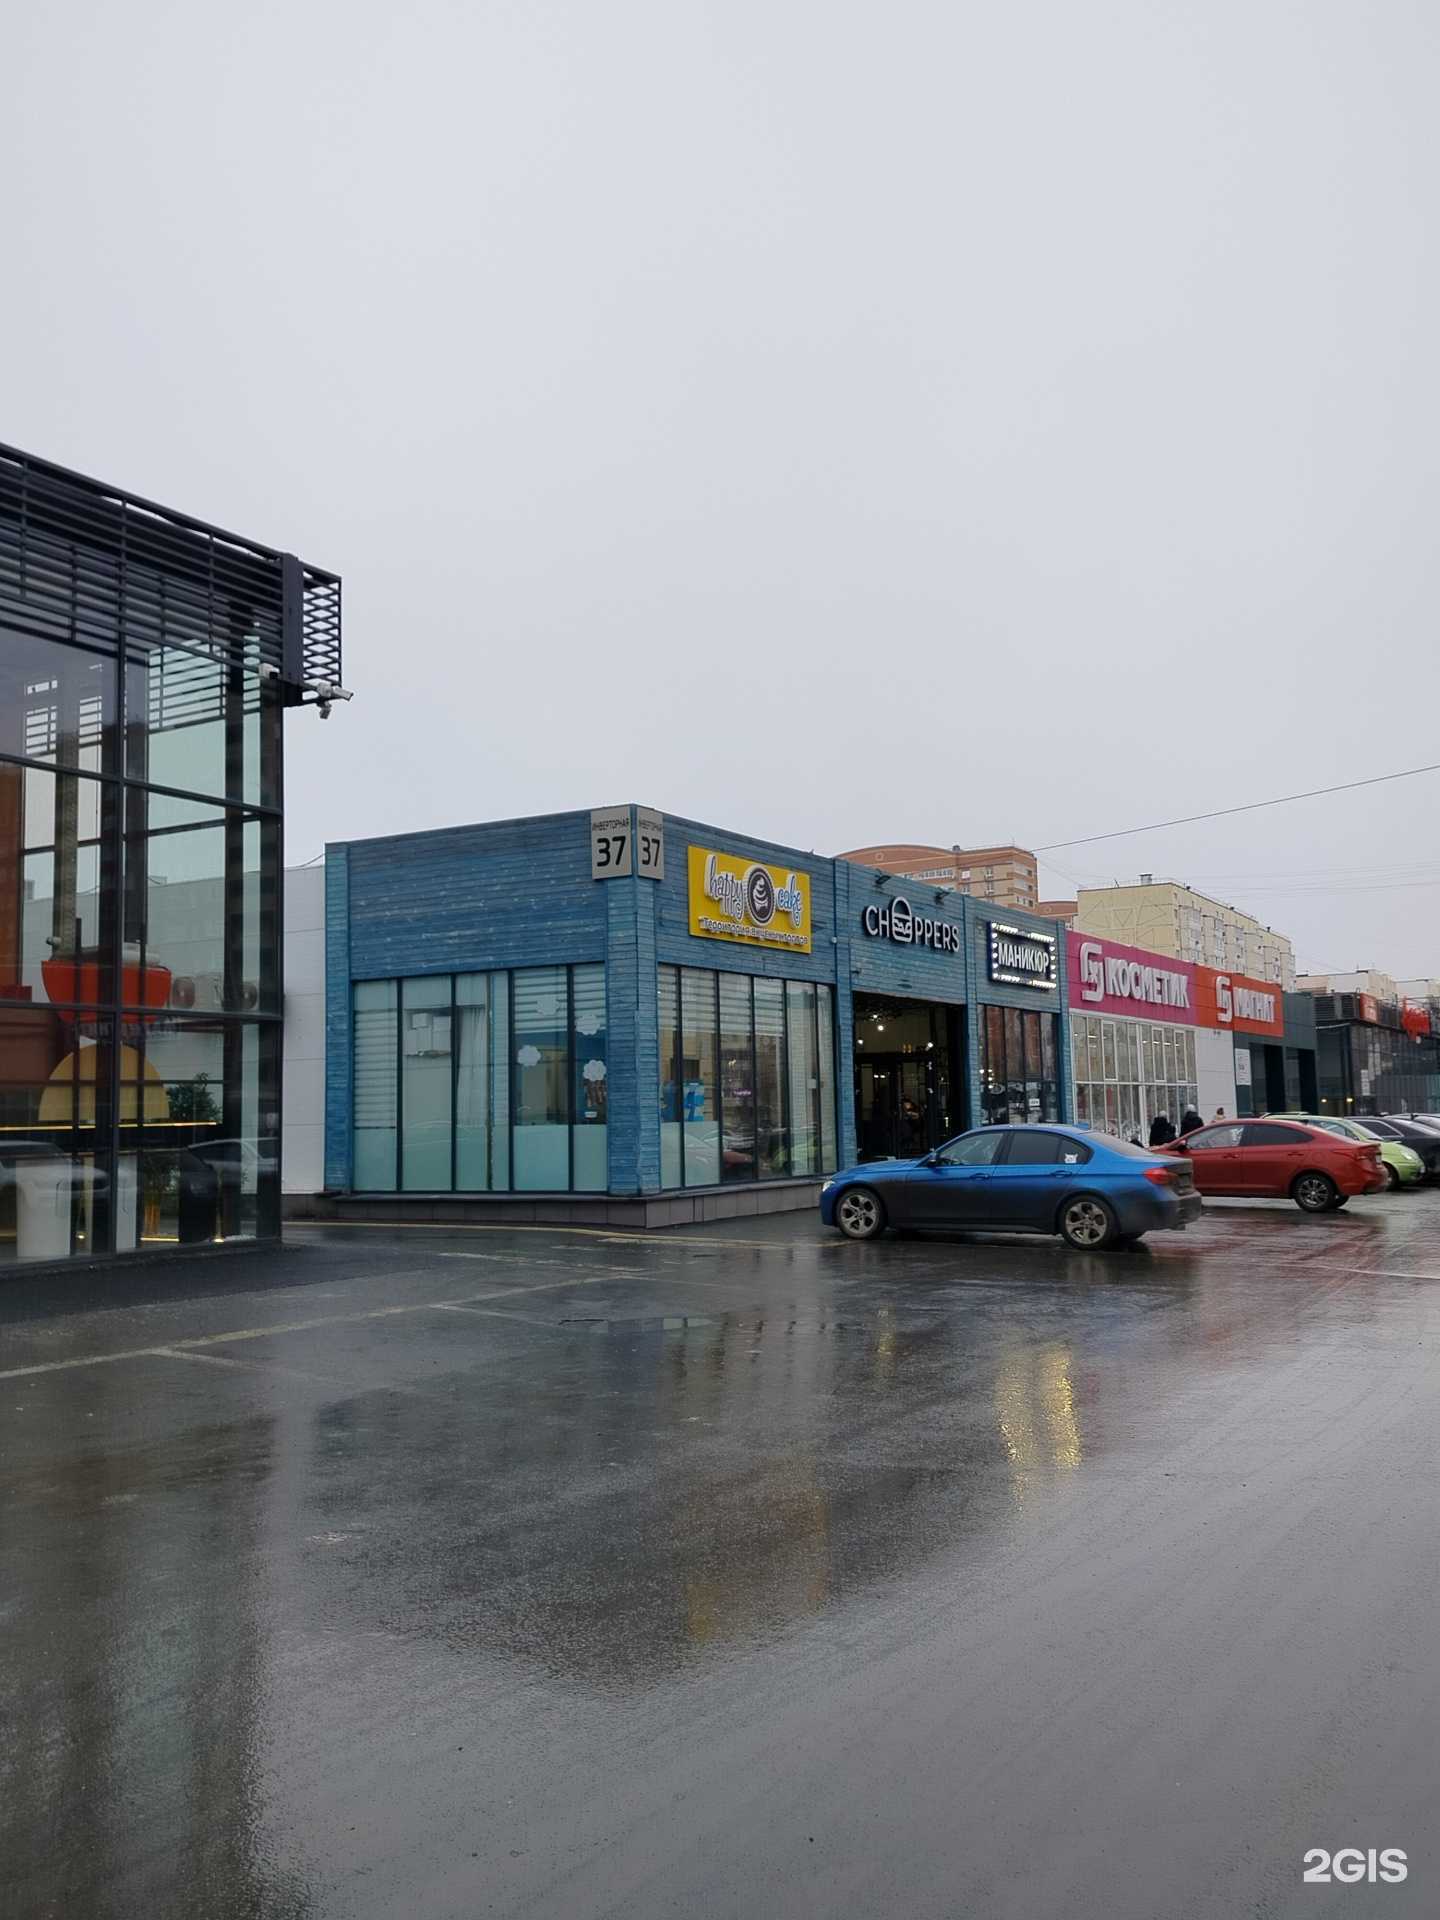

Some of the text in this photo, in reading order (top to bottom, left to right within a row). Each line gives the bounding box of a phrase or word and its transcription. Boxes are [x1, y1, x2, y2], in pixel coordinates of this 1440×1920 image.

[597, 835, 626, 867] 37
[641, 836, 661, 867] 37
[704, 854, 803, 928] happy cake
[998, 942, 1050, 974] МАНИКЮР
[1104, 957, 1190, 1009] КОСМЕТИК
